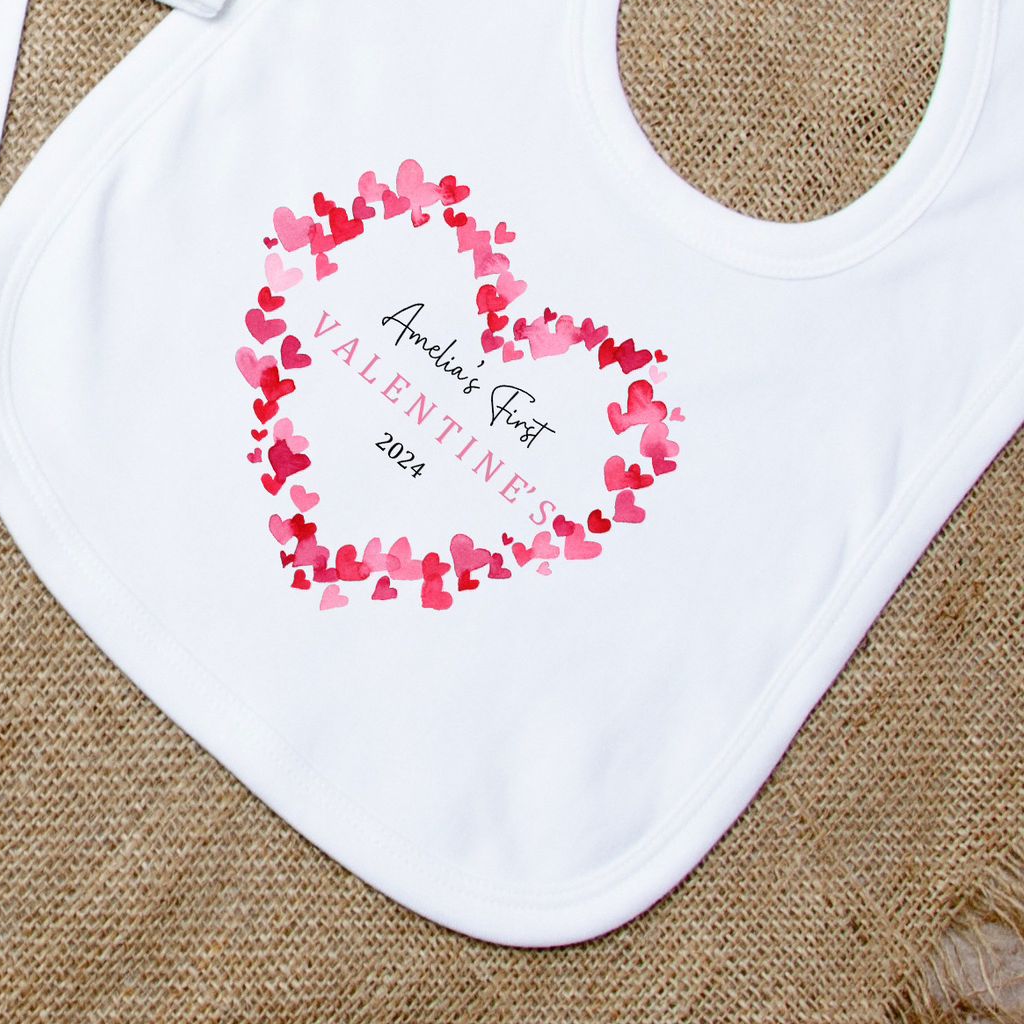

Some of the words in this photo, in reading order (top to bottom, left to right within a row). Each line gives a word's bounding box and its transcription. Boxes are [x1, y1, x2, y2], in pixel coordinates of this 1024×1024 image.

[313, 310, 557, 526] VALENTINE'S
[381, 302, 485, 394] Amelia's
[490, 384, 556, 449] First
[375, 432, 426, 478] 2024
